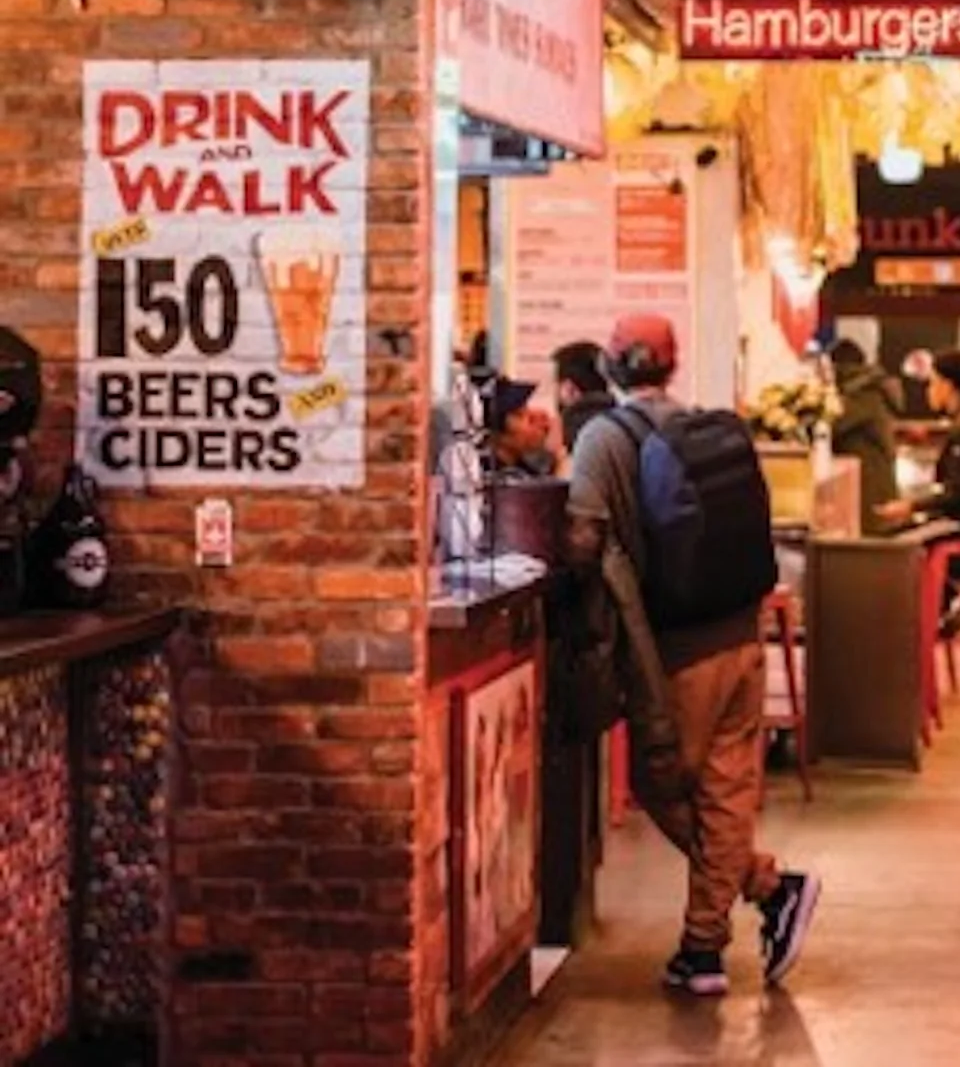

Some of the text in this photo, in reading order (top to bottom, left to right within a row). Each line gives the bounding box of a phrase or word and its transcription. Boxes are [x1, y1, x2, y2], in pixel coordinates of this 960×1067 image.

[99, 90, 351, 158] DRINK
[200, 145, 252, 160] AND
[110, 161, 338, 216] WALK
[96, 255, 239, 358] 150
[98, 372, 281, 420] BEERS
[101, 431, 301, 472] CIDERS
